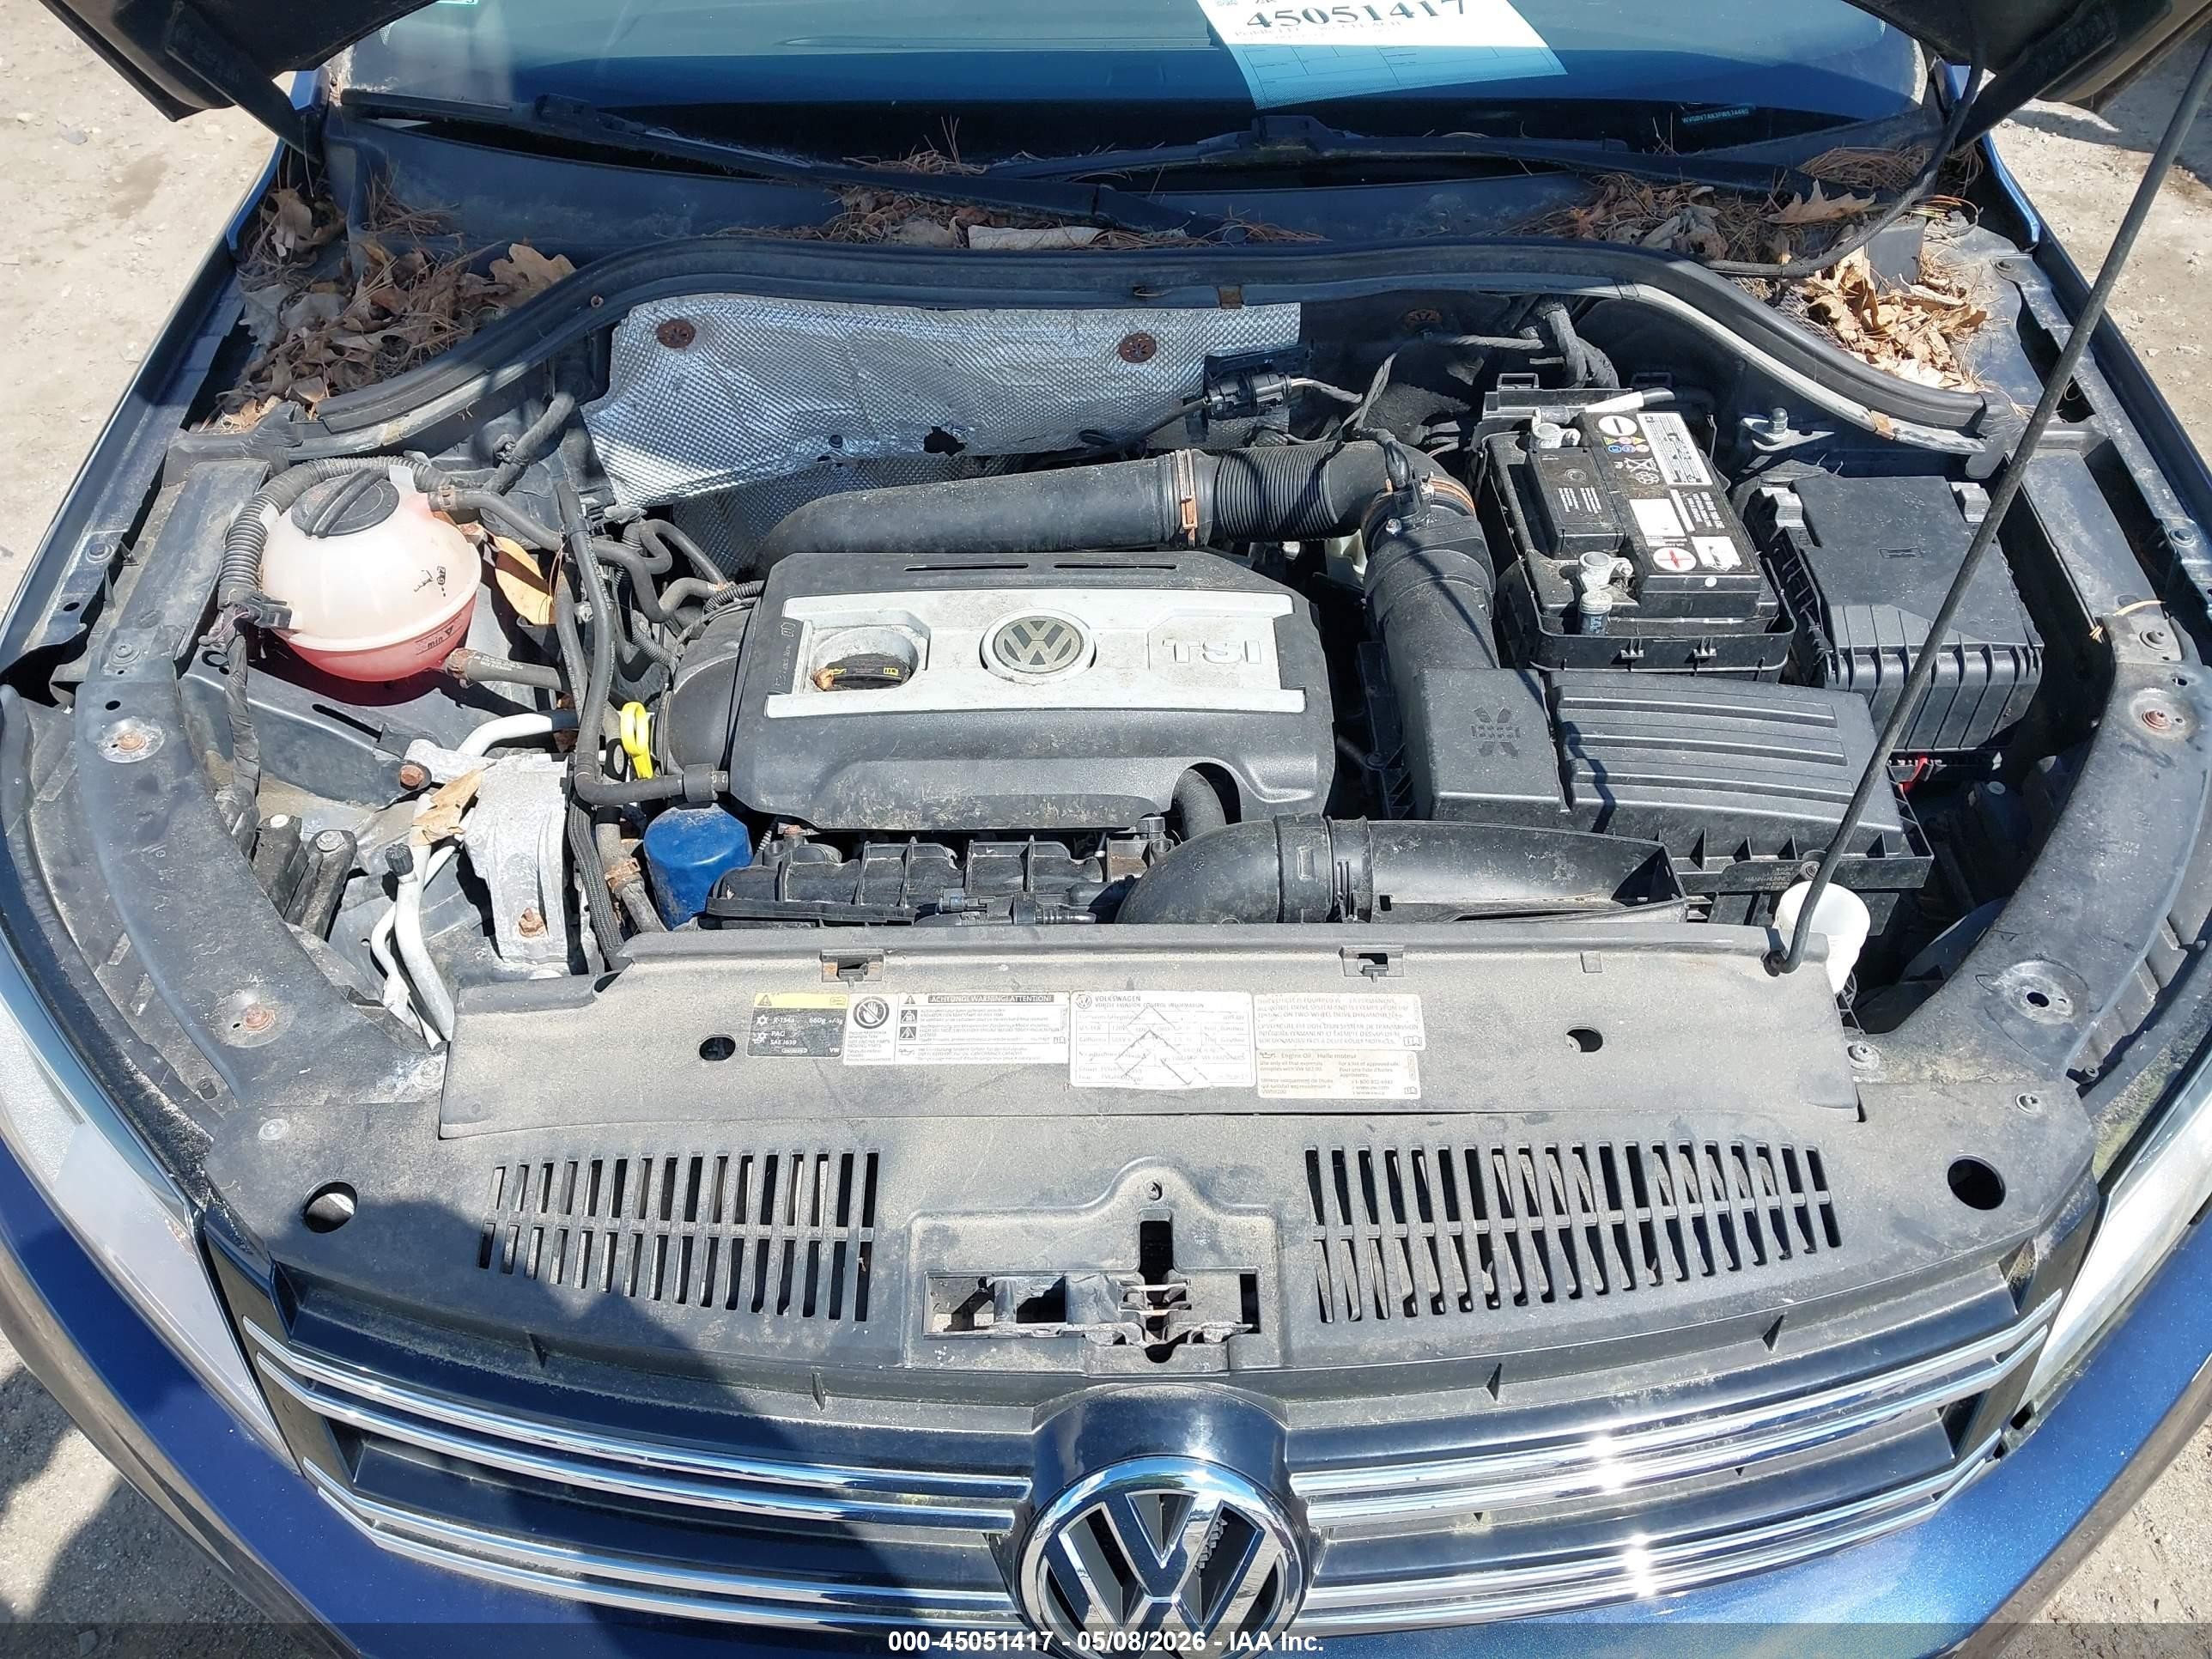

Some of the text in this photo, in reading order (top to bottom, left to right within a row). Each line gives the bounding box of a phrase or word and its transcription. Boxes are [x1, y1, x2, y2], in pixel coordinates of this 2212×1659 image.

[1247, 0, 1465, 28] 45051417
[427, 636, 444, 649] min
[1162, 638, 1261, 664] TSI
